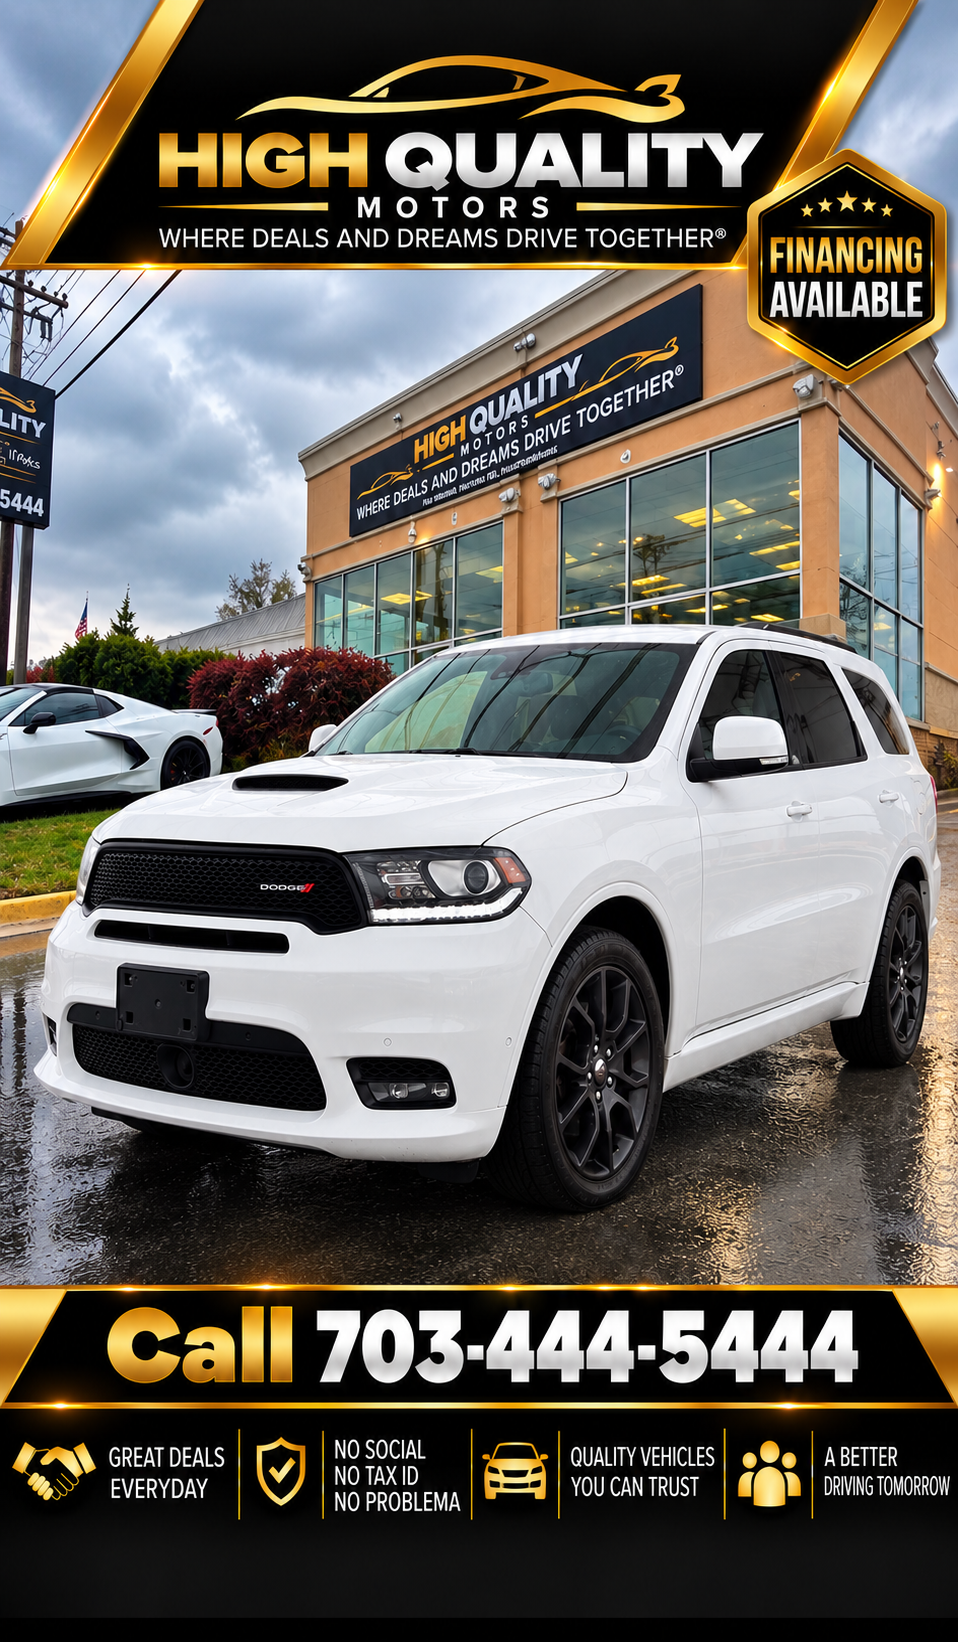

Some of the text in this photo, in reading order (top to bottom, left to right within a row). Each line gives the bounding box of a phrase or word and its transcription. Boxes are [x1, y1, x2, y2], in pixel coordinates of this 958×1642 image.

[413, 353, 584, 464] HIGH QUALITY
[460, 415, 529, 457] MOTORS
[356, 494, 391, 520] WHERE
[393, 479, 428, 506] DEALS
[431, 467, 457, 491] AND
[461, 440, 519, 479] DREAMS
[524, 421, 571, 452] DRIVE
[0, 488, 44, 517] 5444
[260, 883, 306, 891] DODGE
